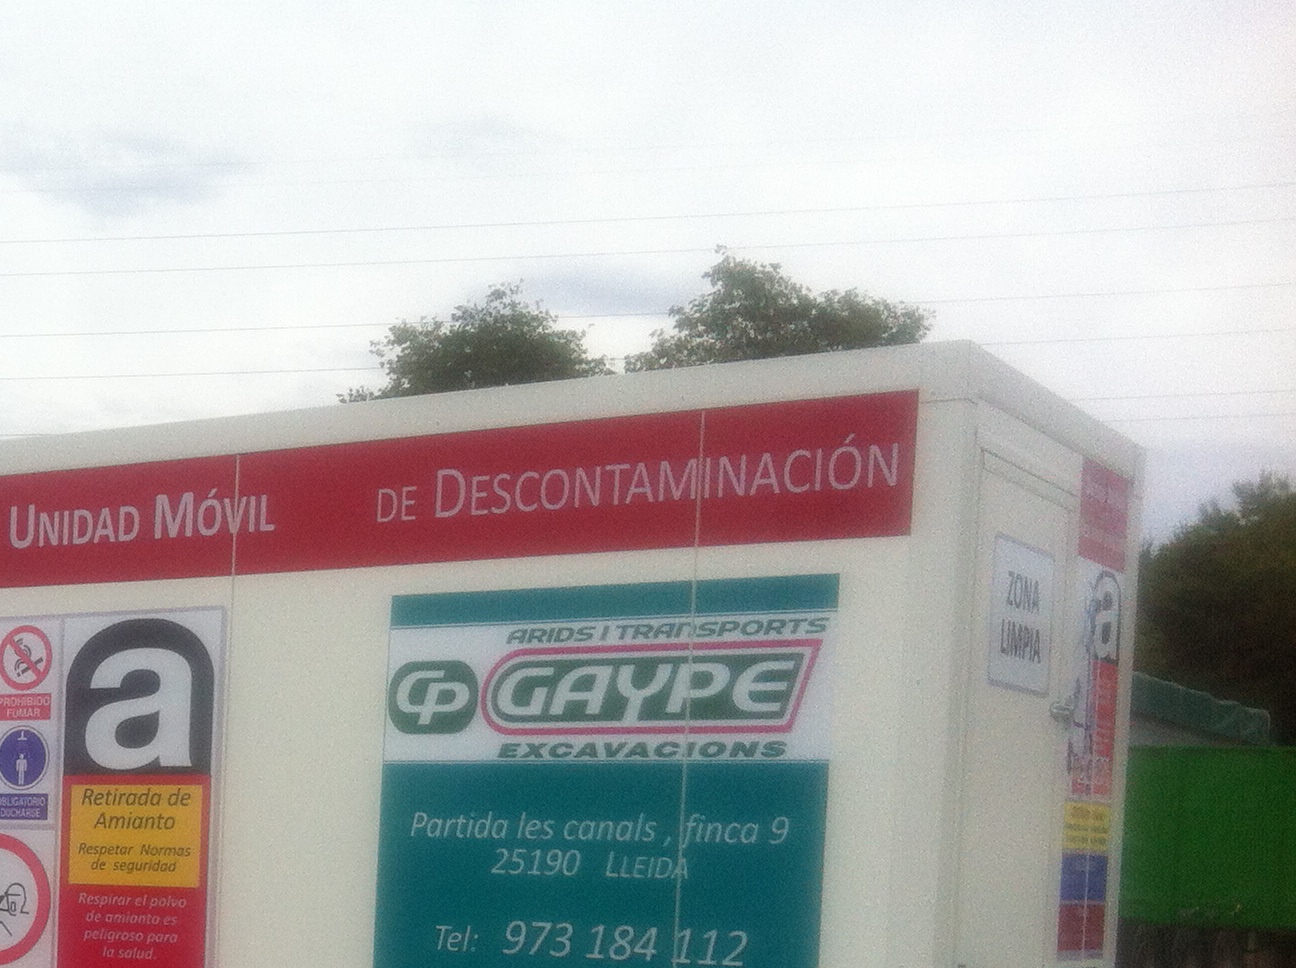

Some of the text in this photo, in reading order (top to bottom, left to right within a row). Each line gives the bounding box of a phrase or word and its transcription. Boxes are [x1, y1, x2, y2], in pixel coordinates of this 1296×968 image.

[9, 433, 900, 549] UNIDAD MÓVIL DE DESCONTAMINACIÓN
[1007, 570, 1040, 615] ZONA
[506, 625, 593, 645] ARIDS
[616, 617, 830, 642] TRANSPORTS
[1000, 618, 1041, 664] LIMPIA
[496, 660, 796, 723] GAYPE
[7, 708, 40, 718] FUMAR
[85, 647, 192, 770] a
[497, 740, 787, 760] EXCAVACIONS
[81, 788, 191, 806] Retirada de
[0, 808, 41, 818] DUCHARSE
[94, 812, 176, 830] Amianto
[410, 811, 507, 840] Partida
[516, 812, 554, 841] les
[680, 814, 759, 849] finca
[770, 816, 790, 845] 9
[78, 842, 191, 859] Respetar Normas
[91, 859, 177, 874] de seguridad
[490, 848, 689, 880] 25190 LLEIDA
[78, 892, 187, 910] Respirar el polvo
[85, 910, 178, 926] de amianto es
[83, 928, 178, 944] peligroso para
[435, 921, 749, 967] Tel: 973 184 112
[102, 946, 115, 958] la
